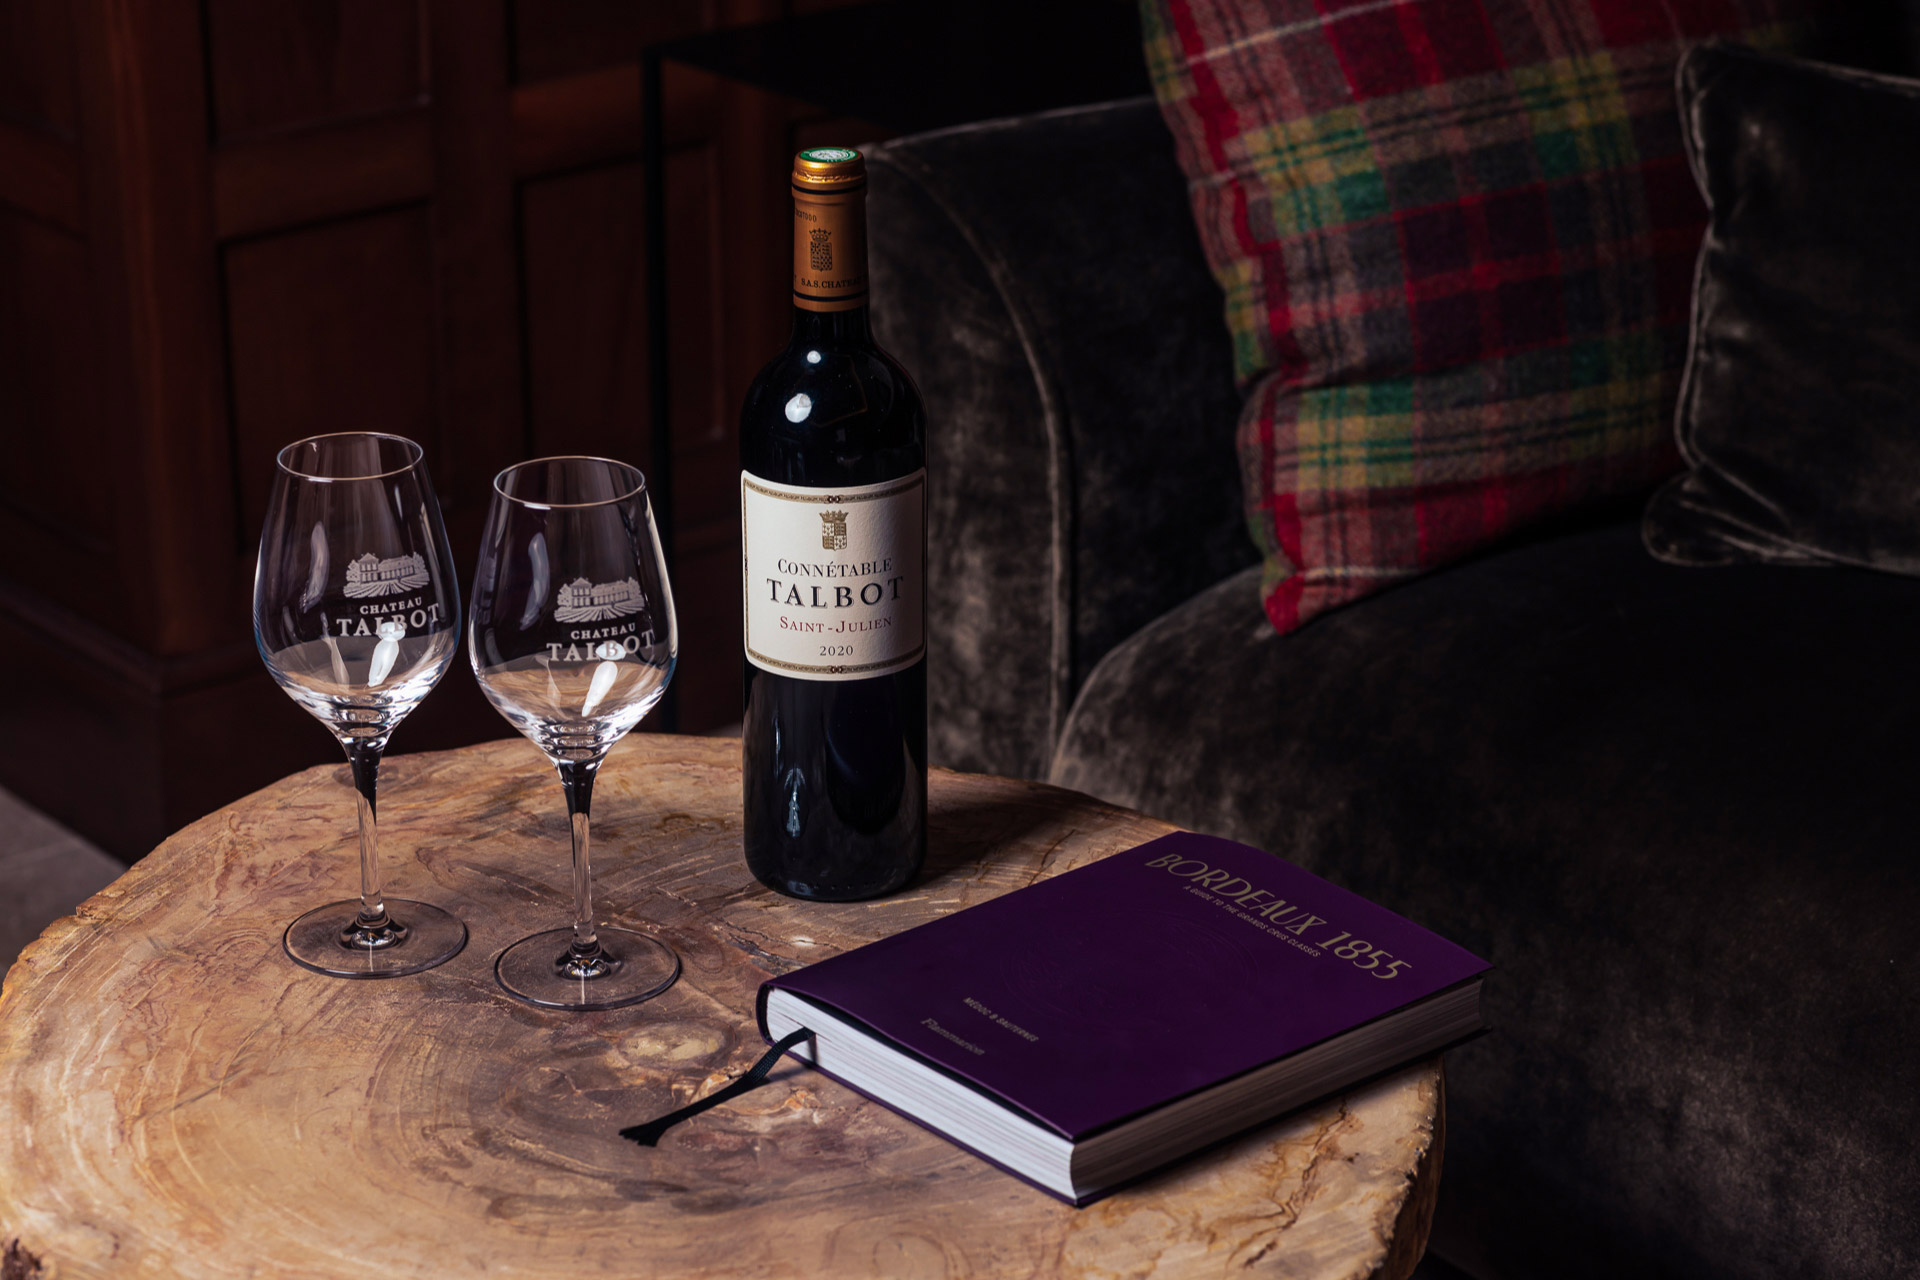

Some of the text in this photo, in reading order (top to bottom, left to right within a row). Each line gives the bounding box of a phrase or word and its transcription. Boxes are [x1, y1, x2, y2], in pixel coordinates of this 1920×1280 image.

[777, 557, 893, 578] CONNÉTABLE
[359, 597, 422, 615] CHATEAU
[766, 576, 904, 609] TALBOT
[336, 603, 439, 637] TALBOT
[570, 622, 636, 640] CHATEAU
[546, 629, 655, 662] TALBOT
[819, 645, 854, 657] 2020
[1144, 853, 1413, 979] BORDEAUX 1855
[1190, 888, 1215, 901] GUIDE
[1213, 898, 1225, 907] TO
[1222, 904, 1240, 915] THE
[1237, 912, 1269, 931] GRANDS
[1266, 927, 1290, 941] CRUS
